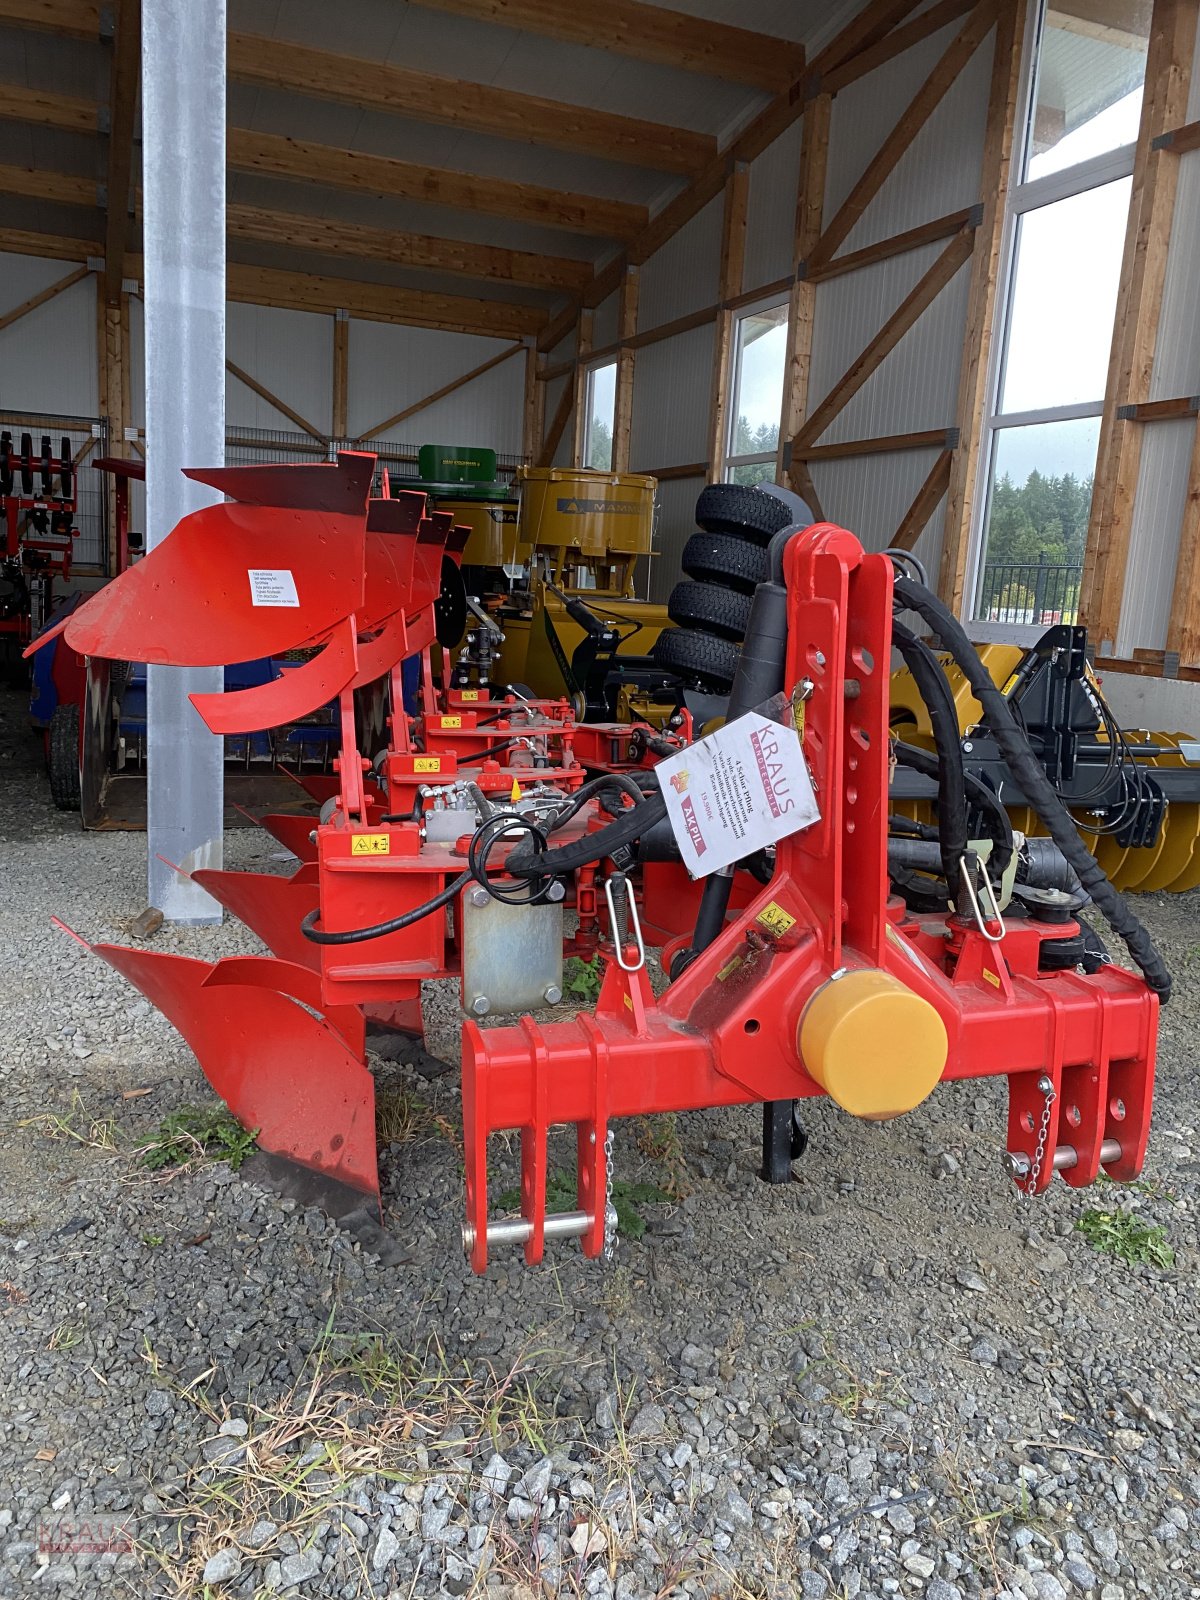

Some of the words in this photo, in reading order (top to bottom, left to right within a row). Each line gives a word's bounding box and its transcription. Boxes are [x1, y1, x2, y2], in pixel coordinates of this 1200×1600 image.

[737, 766, 747, 790] Schar
[744, 791, 754, 814] Pflug
[752, 736, 779, 813] LANDTECHNIK
[758, 724, 795, 814] KRAUS
[701, 791, 714, 821] 19.900€
[714, 792, 729, 829] Durchgang
[718, 750, 726, 769] Vario
[722, 769, 747, 838] Schnittverbreiterung
[731, 775, 749, 824] Steinsicherung
[683, 806, 702, 846] AKPIL
[724, 801, 741, 840] Kverneland
